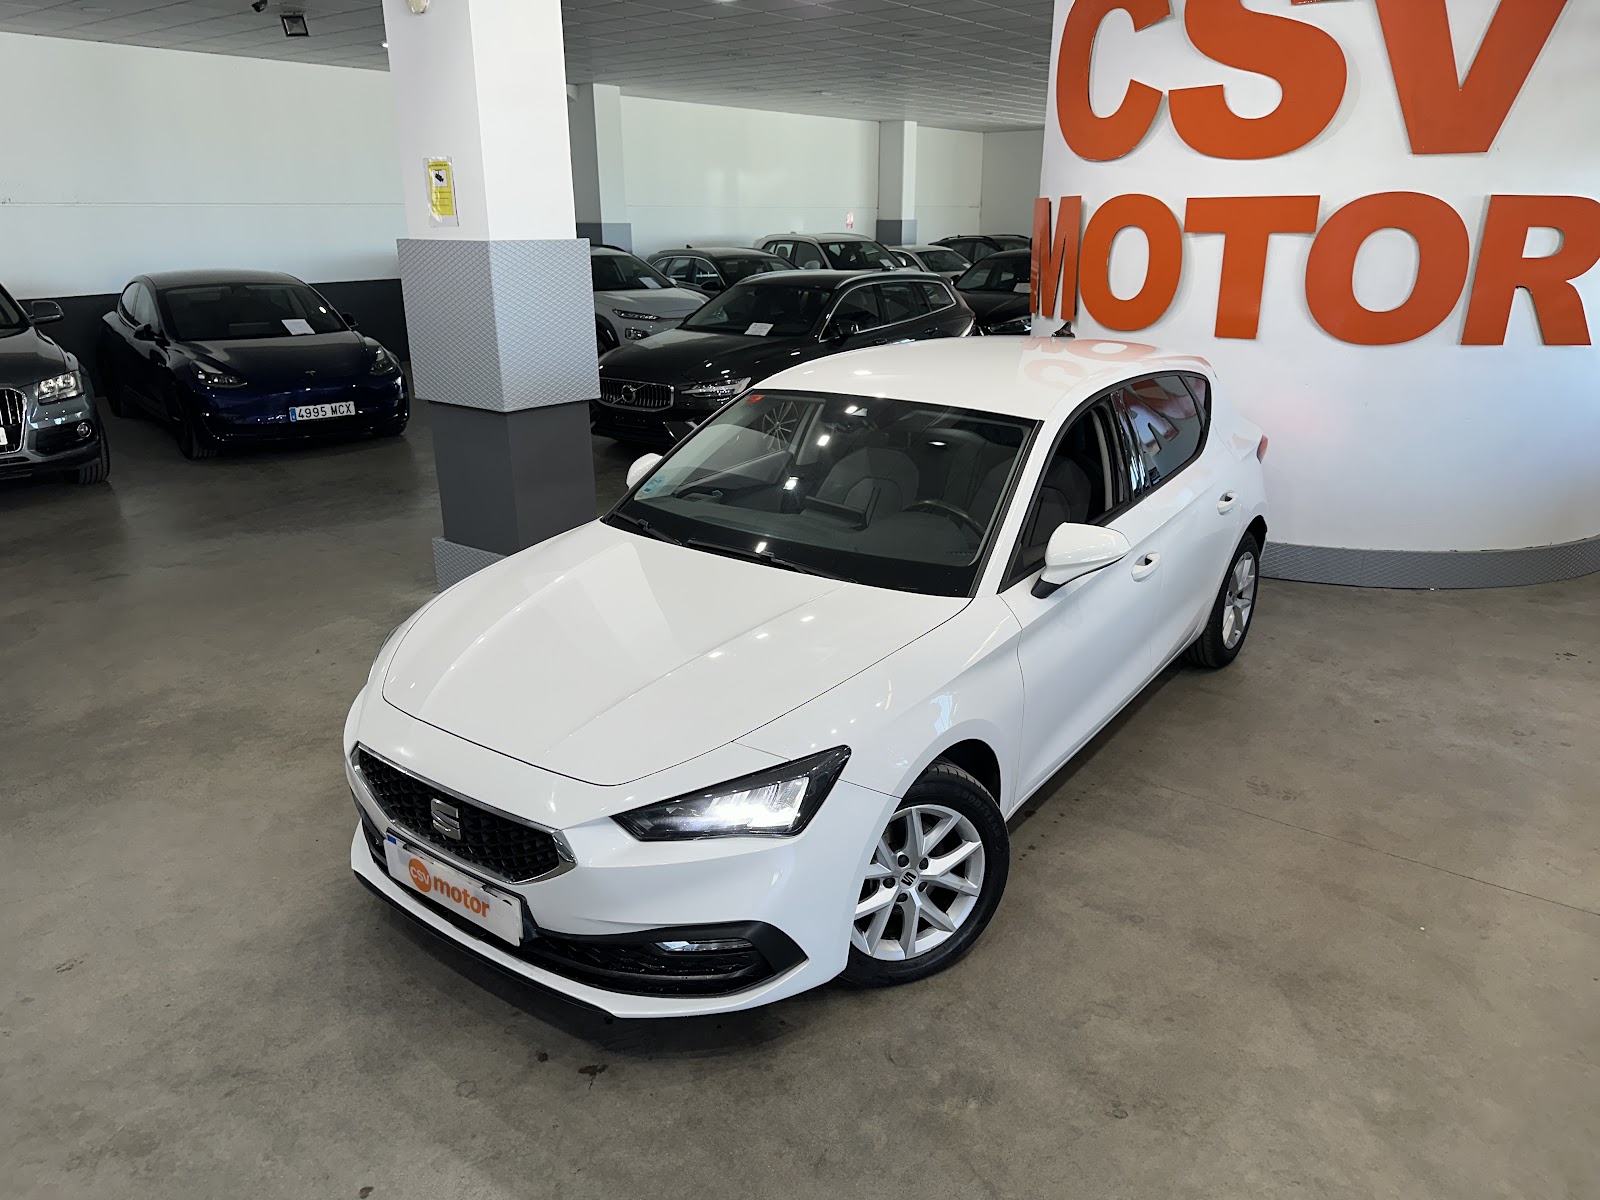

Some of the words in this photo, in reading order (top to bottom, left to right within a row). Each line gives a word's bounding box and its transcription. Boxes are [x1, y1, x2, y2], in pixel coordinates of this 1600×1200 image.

[1056, 0, 1570, 161] CSV
[1030, 191, 1600, 346] MOTOR
[298, 407, 327, 418] 4995
[330, 403, 352, 416] MCX
[433, 875, 490, 918] motor
